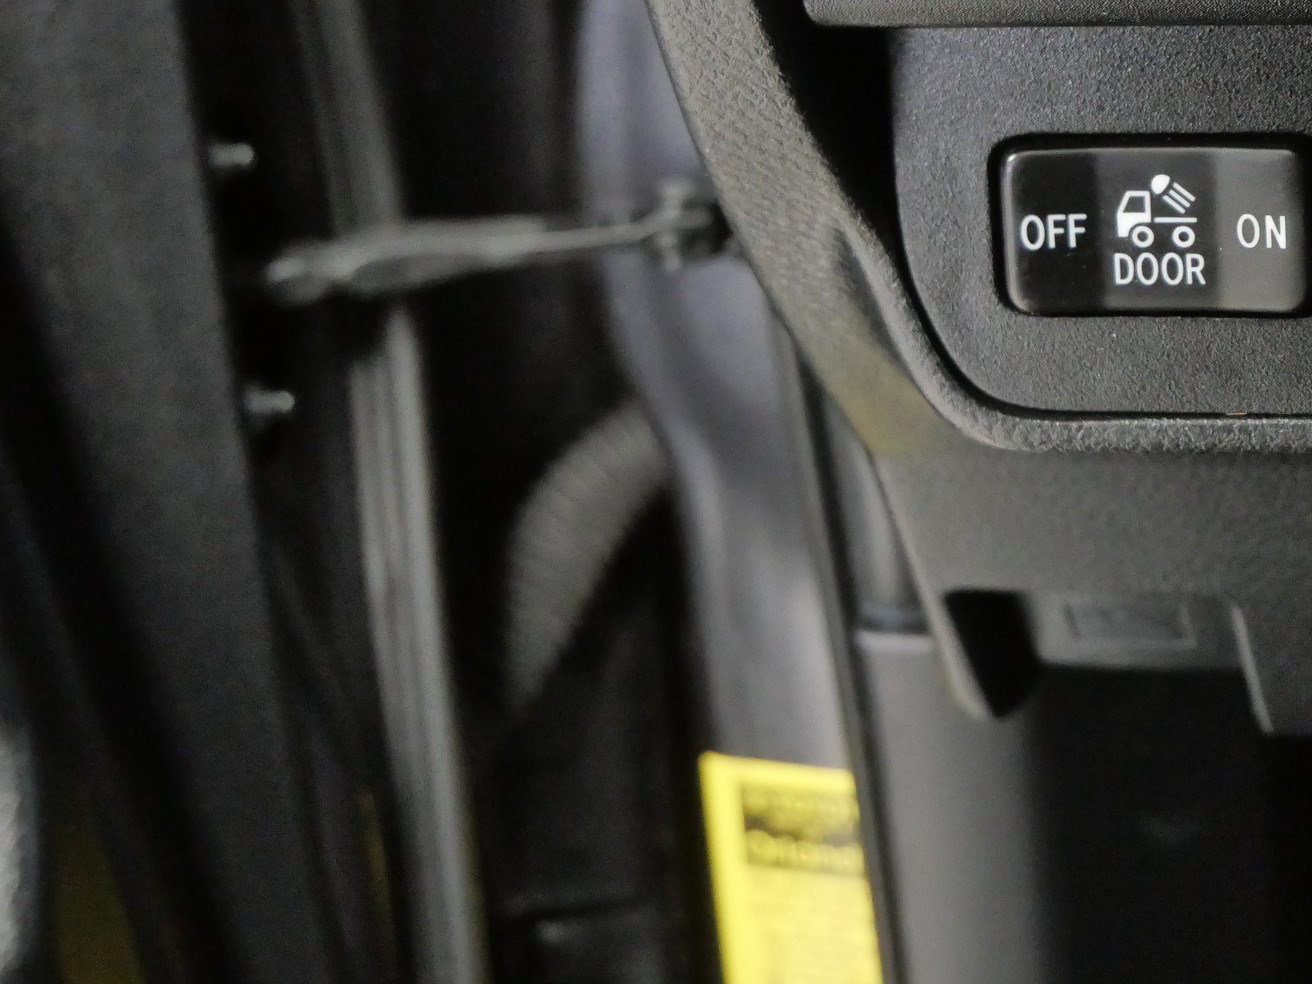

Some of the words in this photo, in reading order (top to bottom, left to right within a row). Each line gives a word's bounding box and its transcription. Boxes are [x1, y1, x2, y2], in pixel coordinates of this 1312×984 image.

[1020, 213, 1088, 251] OFF
[1236, 213, 1287, 249] ON
[1113, 253, 1206, 285] DOOR
